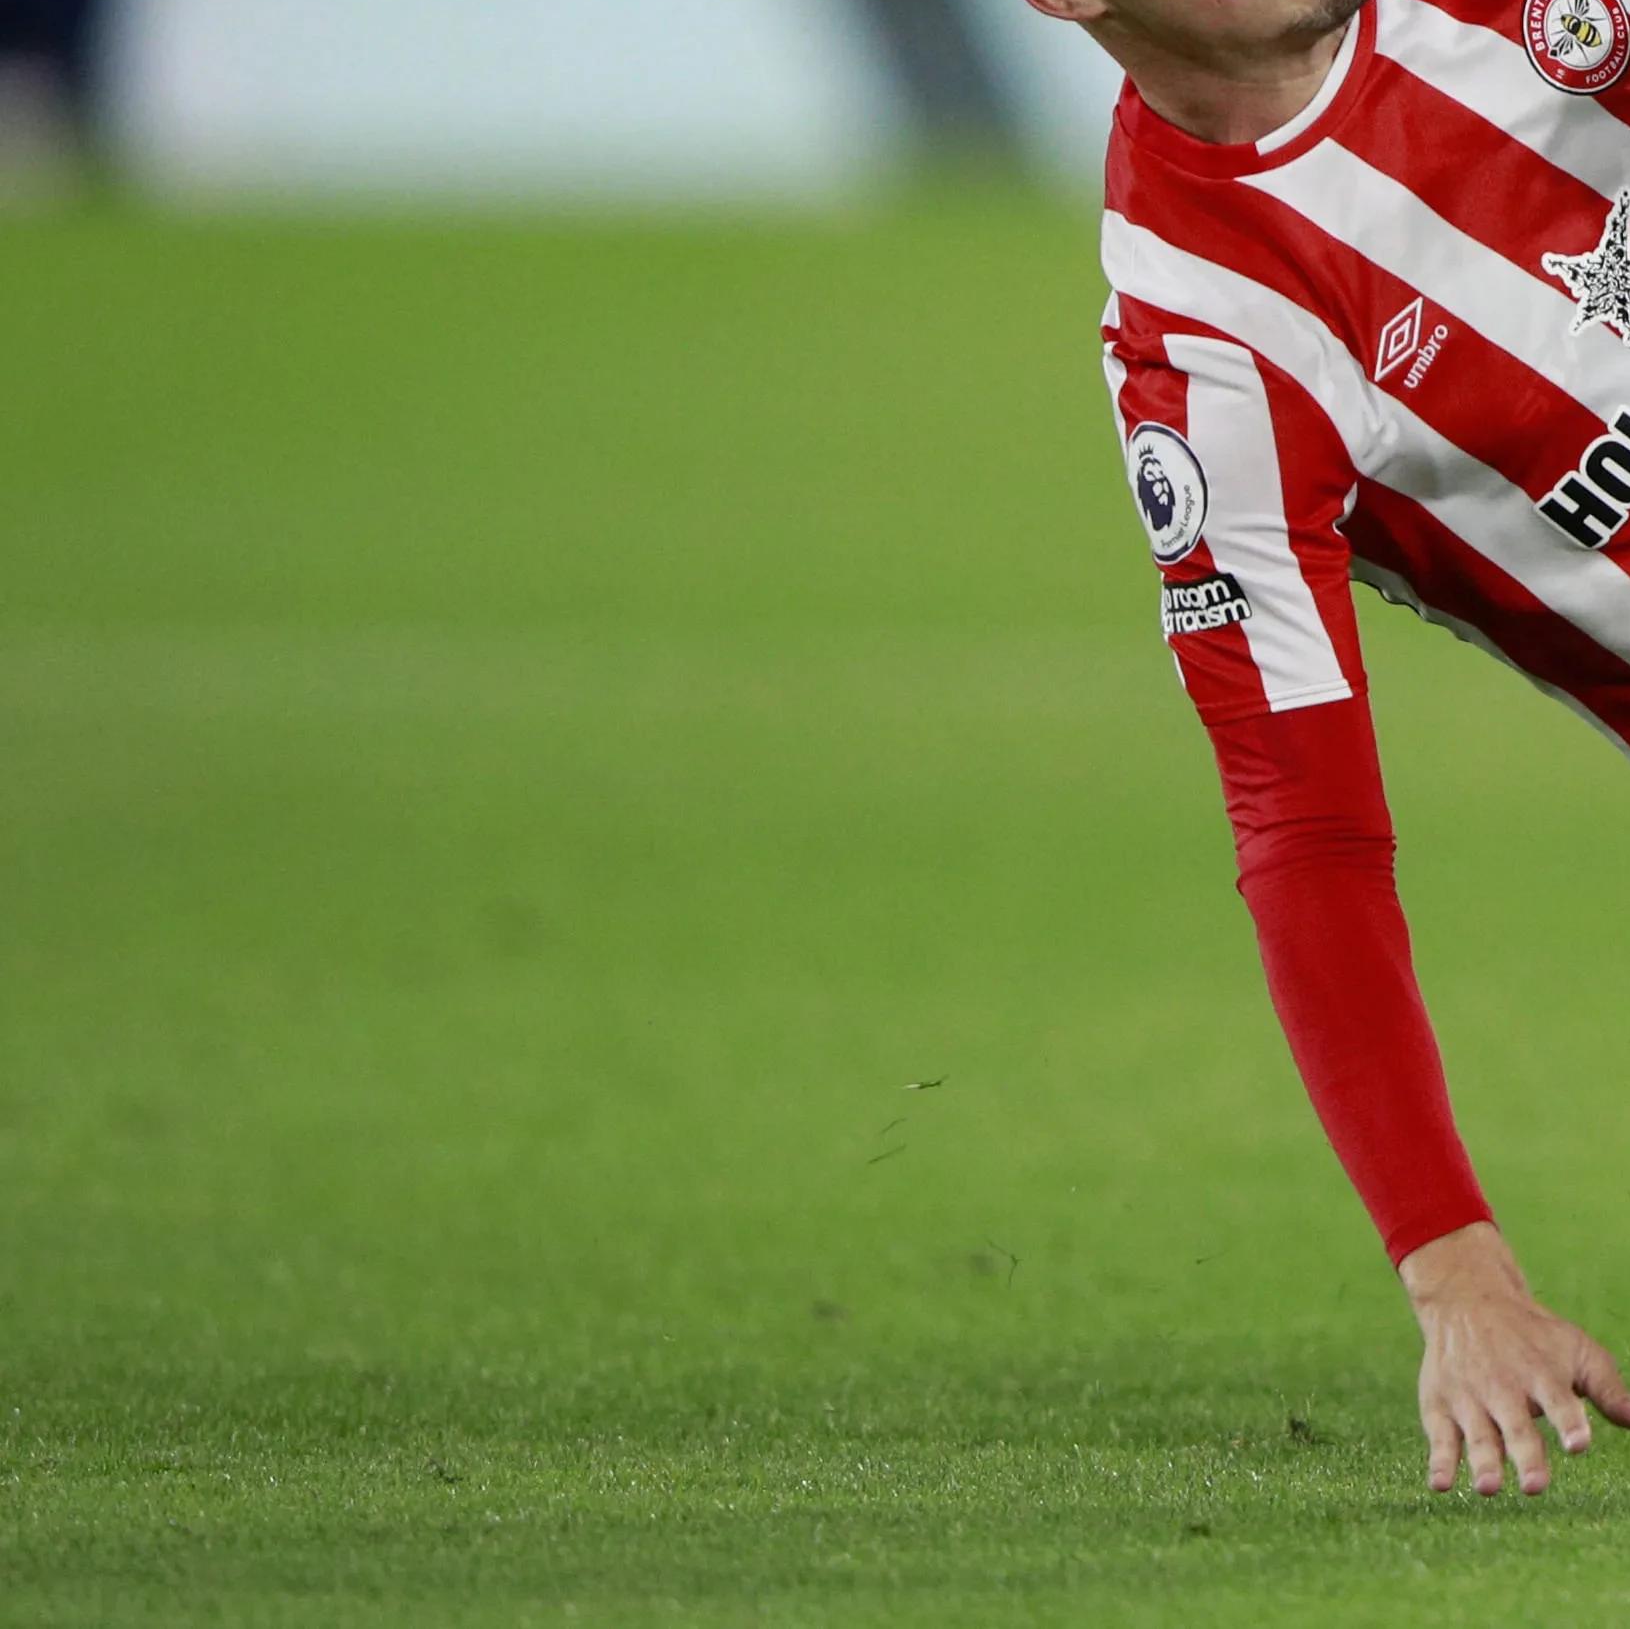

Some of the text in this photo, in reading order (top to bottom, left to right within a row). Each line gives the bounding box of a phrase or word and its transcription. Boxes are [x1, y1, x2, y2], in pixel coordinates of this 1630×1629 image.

[1585, 8, 1625, 84] FOOTBALL CLUB
[1404, 324, 1449, 388] umbro
[1180, 484, 1196, 527] League
[1171, 579, 1231, 610] room
[1174, 598, 1251, 632] racism
